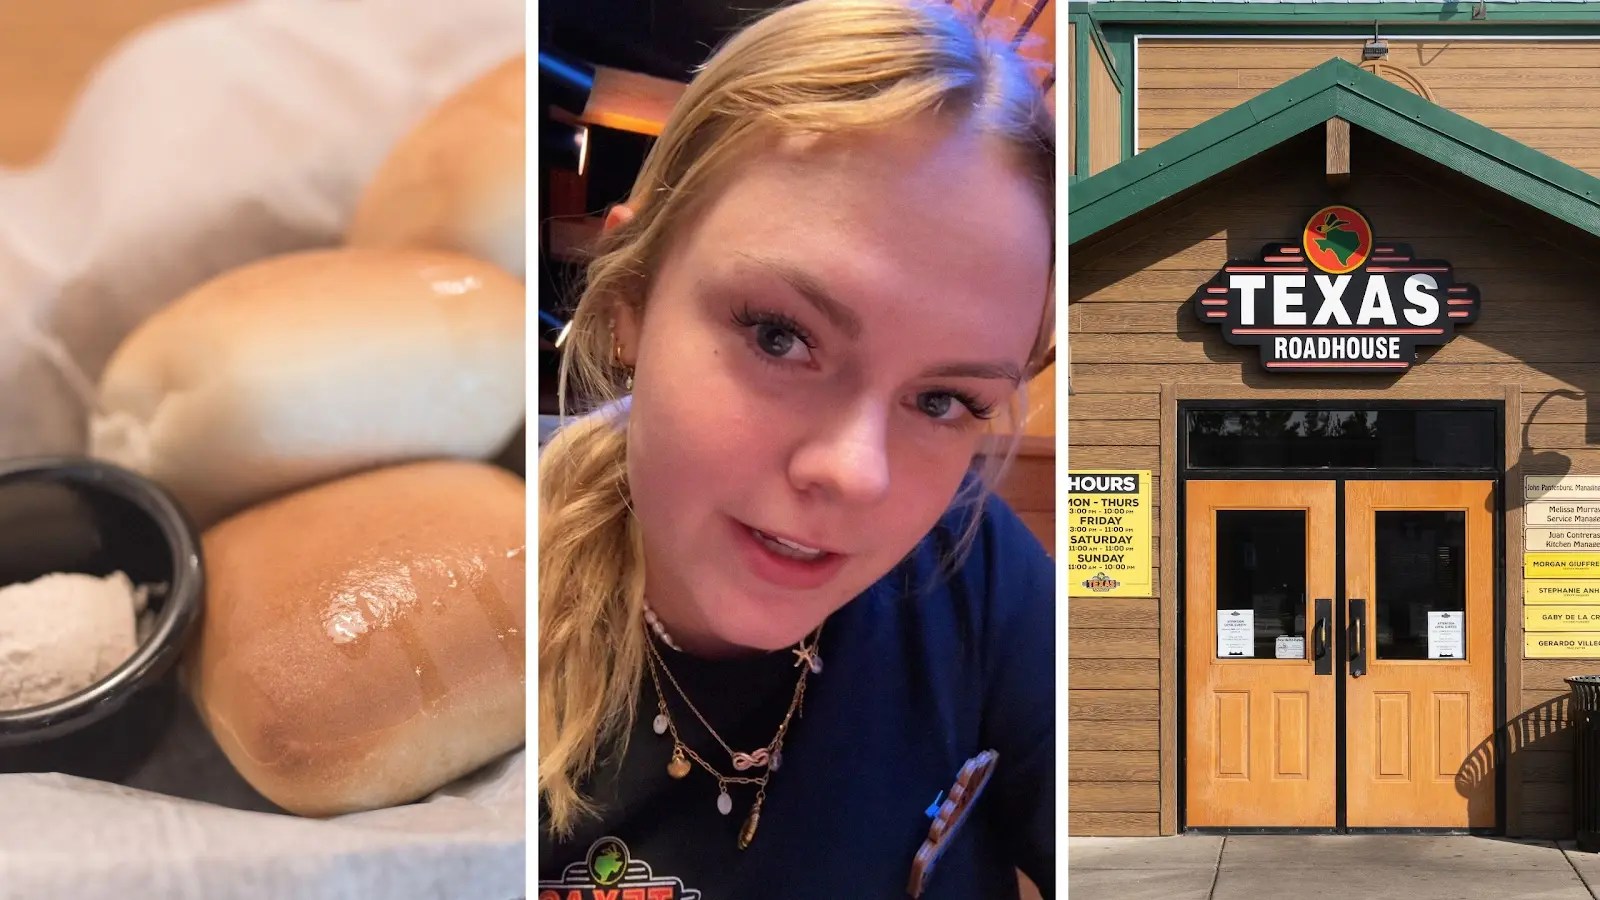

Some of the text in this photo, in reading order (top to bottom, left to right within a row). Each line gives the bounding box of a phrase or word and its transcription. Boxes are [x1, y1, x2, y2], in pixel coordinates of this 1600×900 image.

[1229, 273, 1440, 326] TEXAS
[1274, 336, 1400, 359] ROADHOUSE
[1068, 476, 1135, 491] HOURS
[1101, 498, 1139, 507] THURS
[1080, 516, 1122, 525] FRIDAY
[1070, 535, 1133, 544] SATURDAY
[1549, 531, 1564, 539] Juan
[1546, 540, 1572, 548] Kitchen
[1078, 554, 1124, 562] SUNDAY
